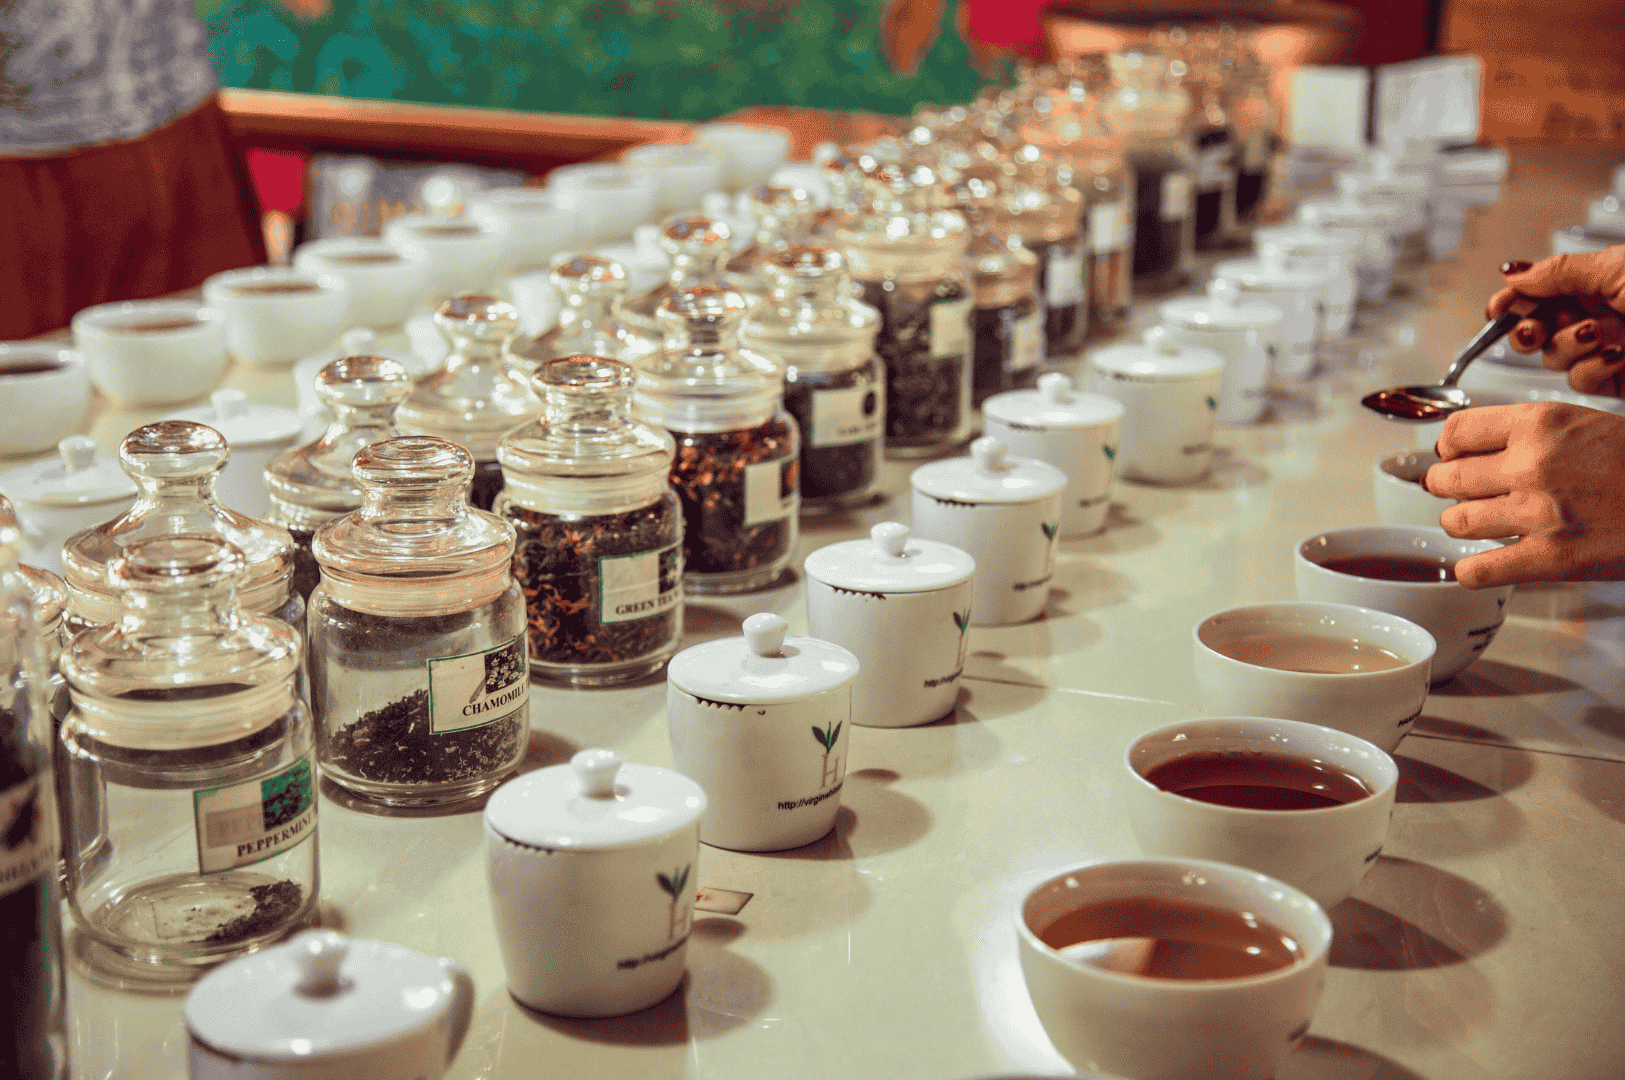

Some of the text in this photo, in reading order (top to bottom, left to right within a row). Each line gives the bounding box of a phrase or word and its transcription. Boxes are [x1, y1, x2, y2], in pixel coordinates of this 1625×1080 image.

[615, 600, 655, 616] GREEN
[462, 682, 525, 717] CHAMOMILE
[237, 811, 312, 858] PEPPERMINT
